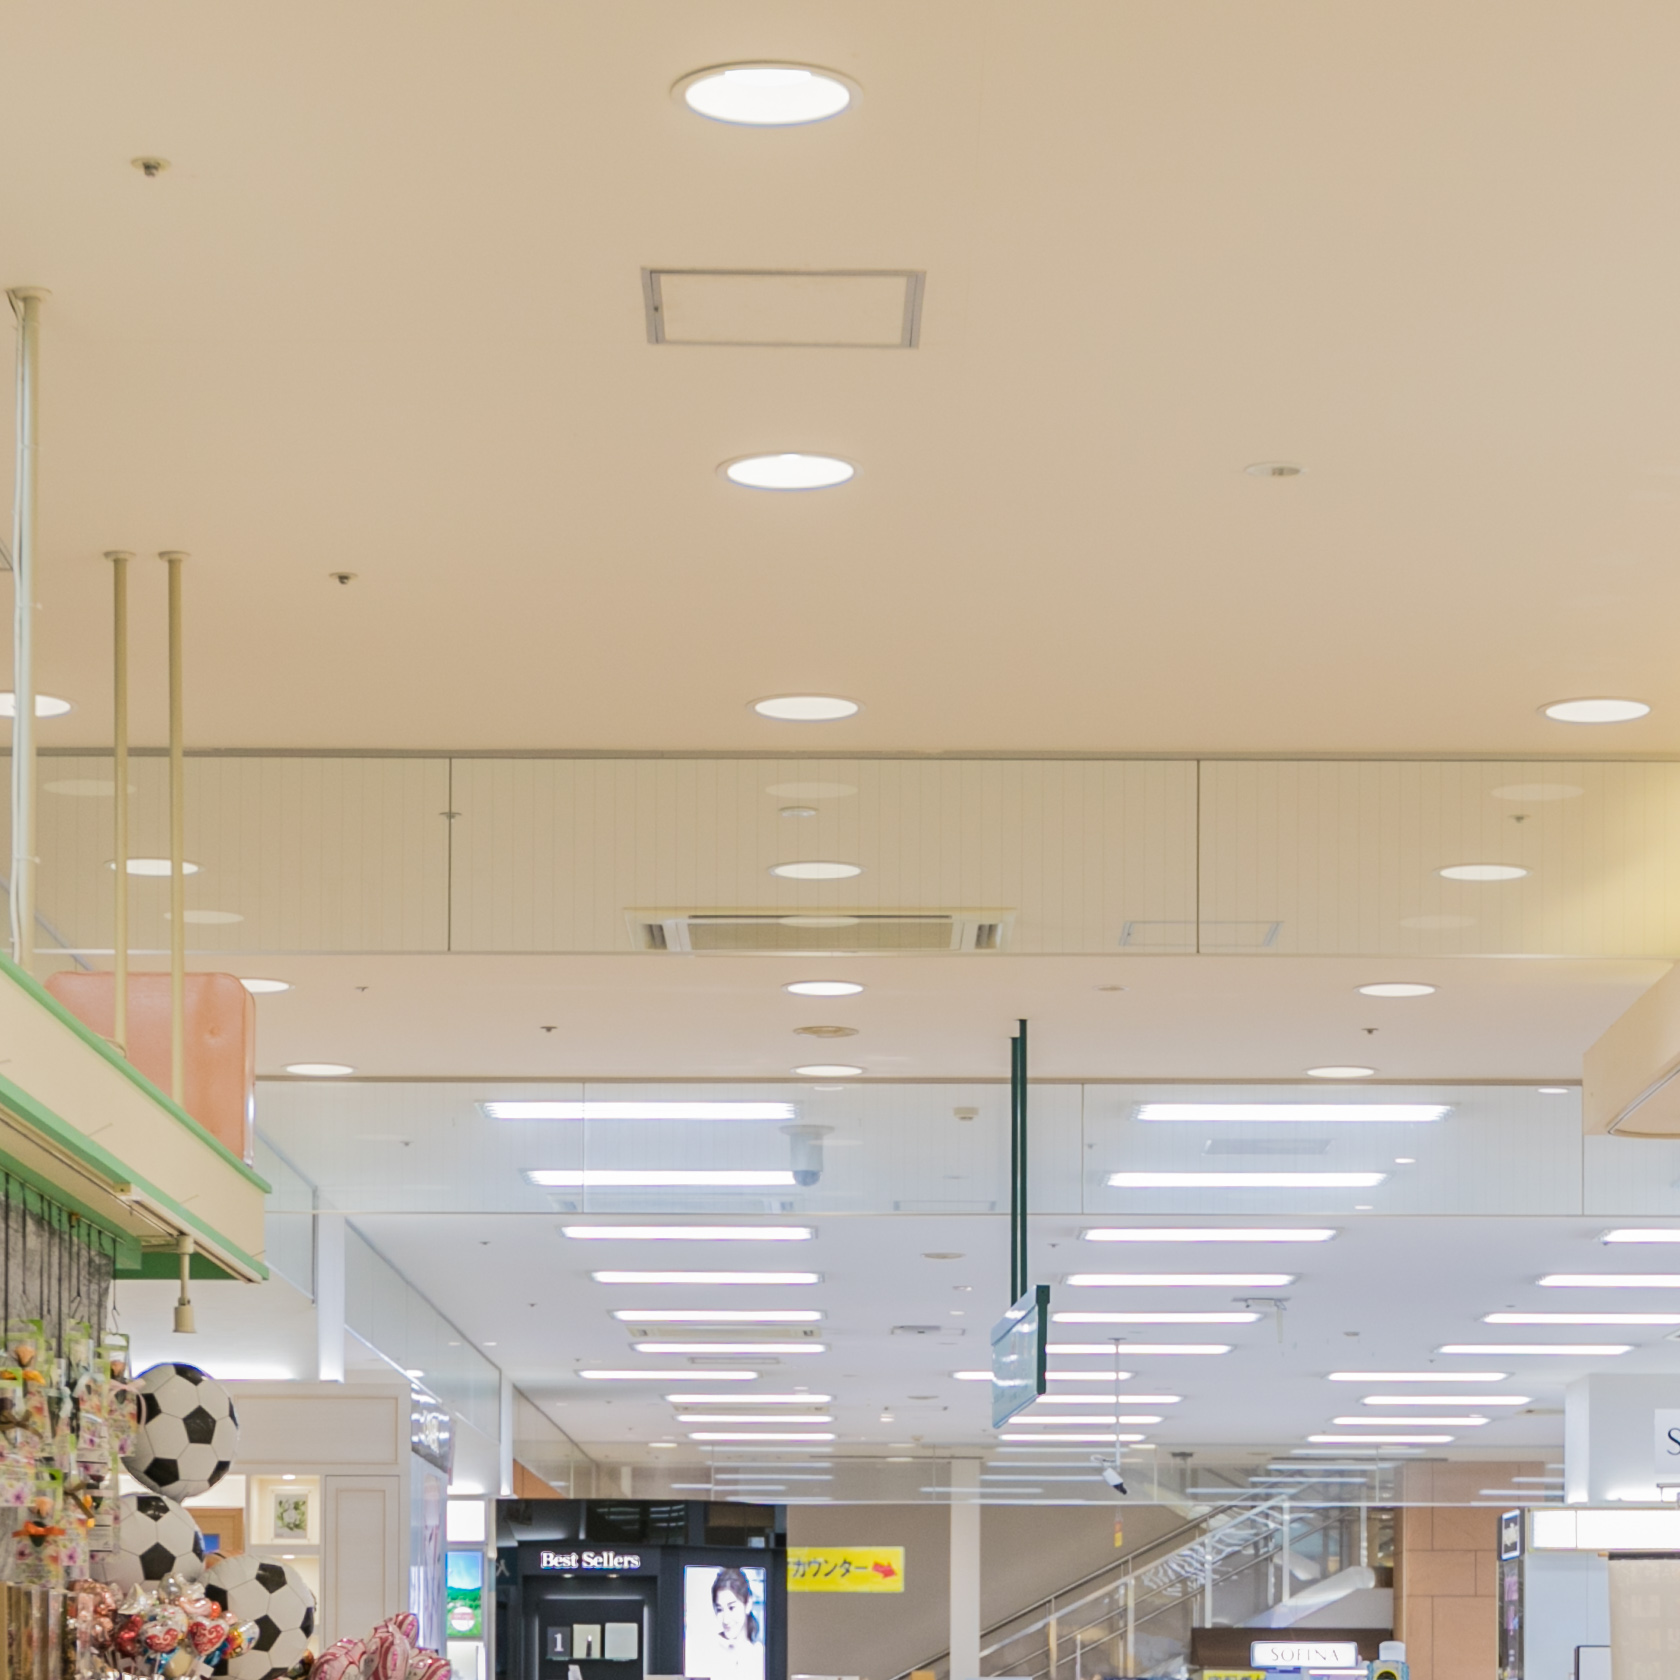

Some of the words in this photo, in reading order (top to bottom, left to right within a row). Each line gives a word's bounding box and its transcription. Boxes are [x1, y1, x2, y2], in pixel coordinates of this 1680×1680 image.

[541, 1551, 578, 1568] Best
[581, 1551, 640, 1568] Sellers
[792, 1557, 869, 1579] カウンター
[553, 1633, 564, 1652] 1
[1270, 1647, 1340, 1662] SOFINA
